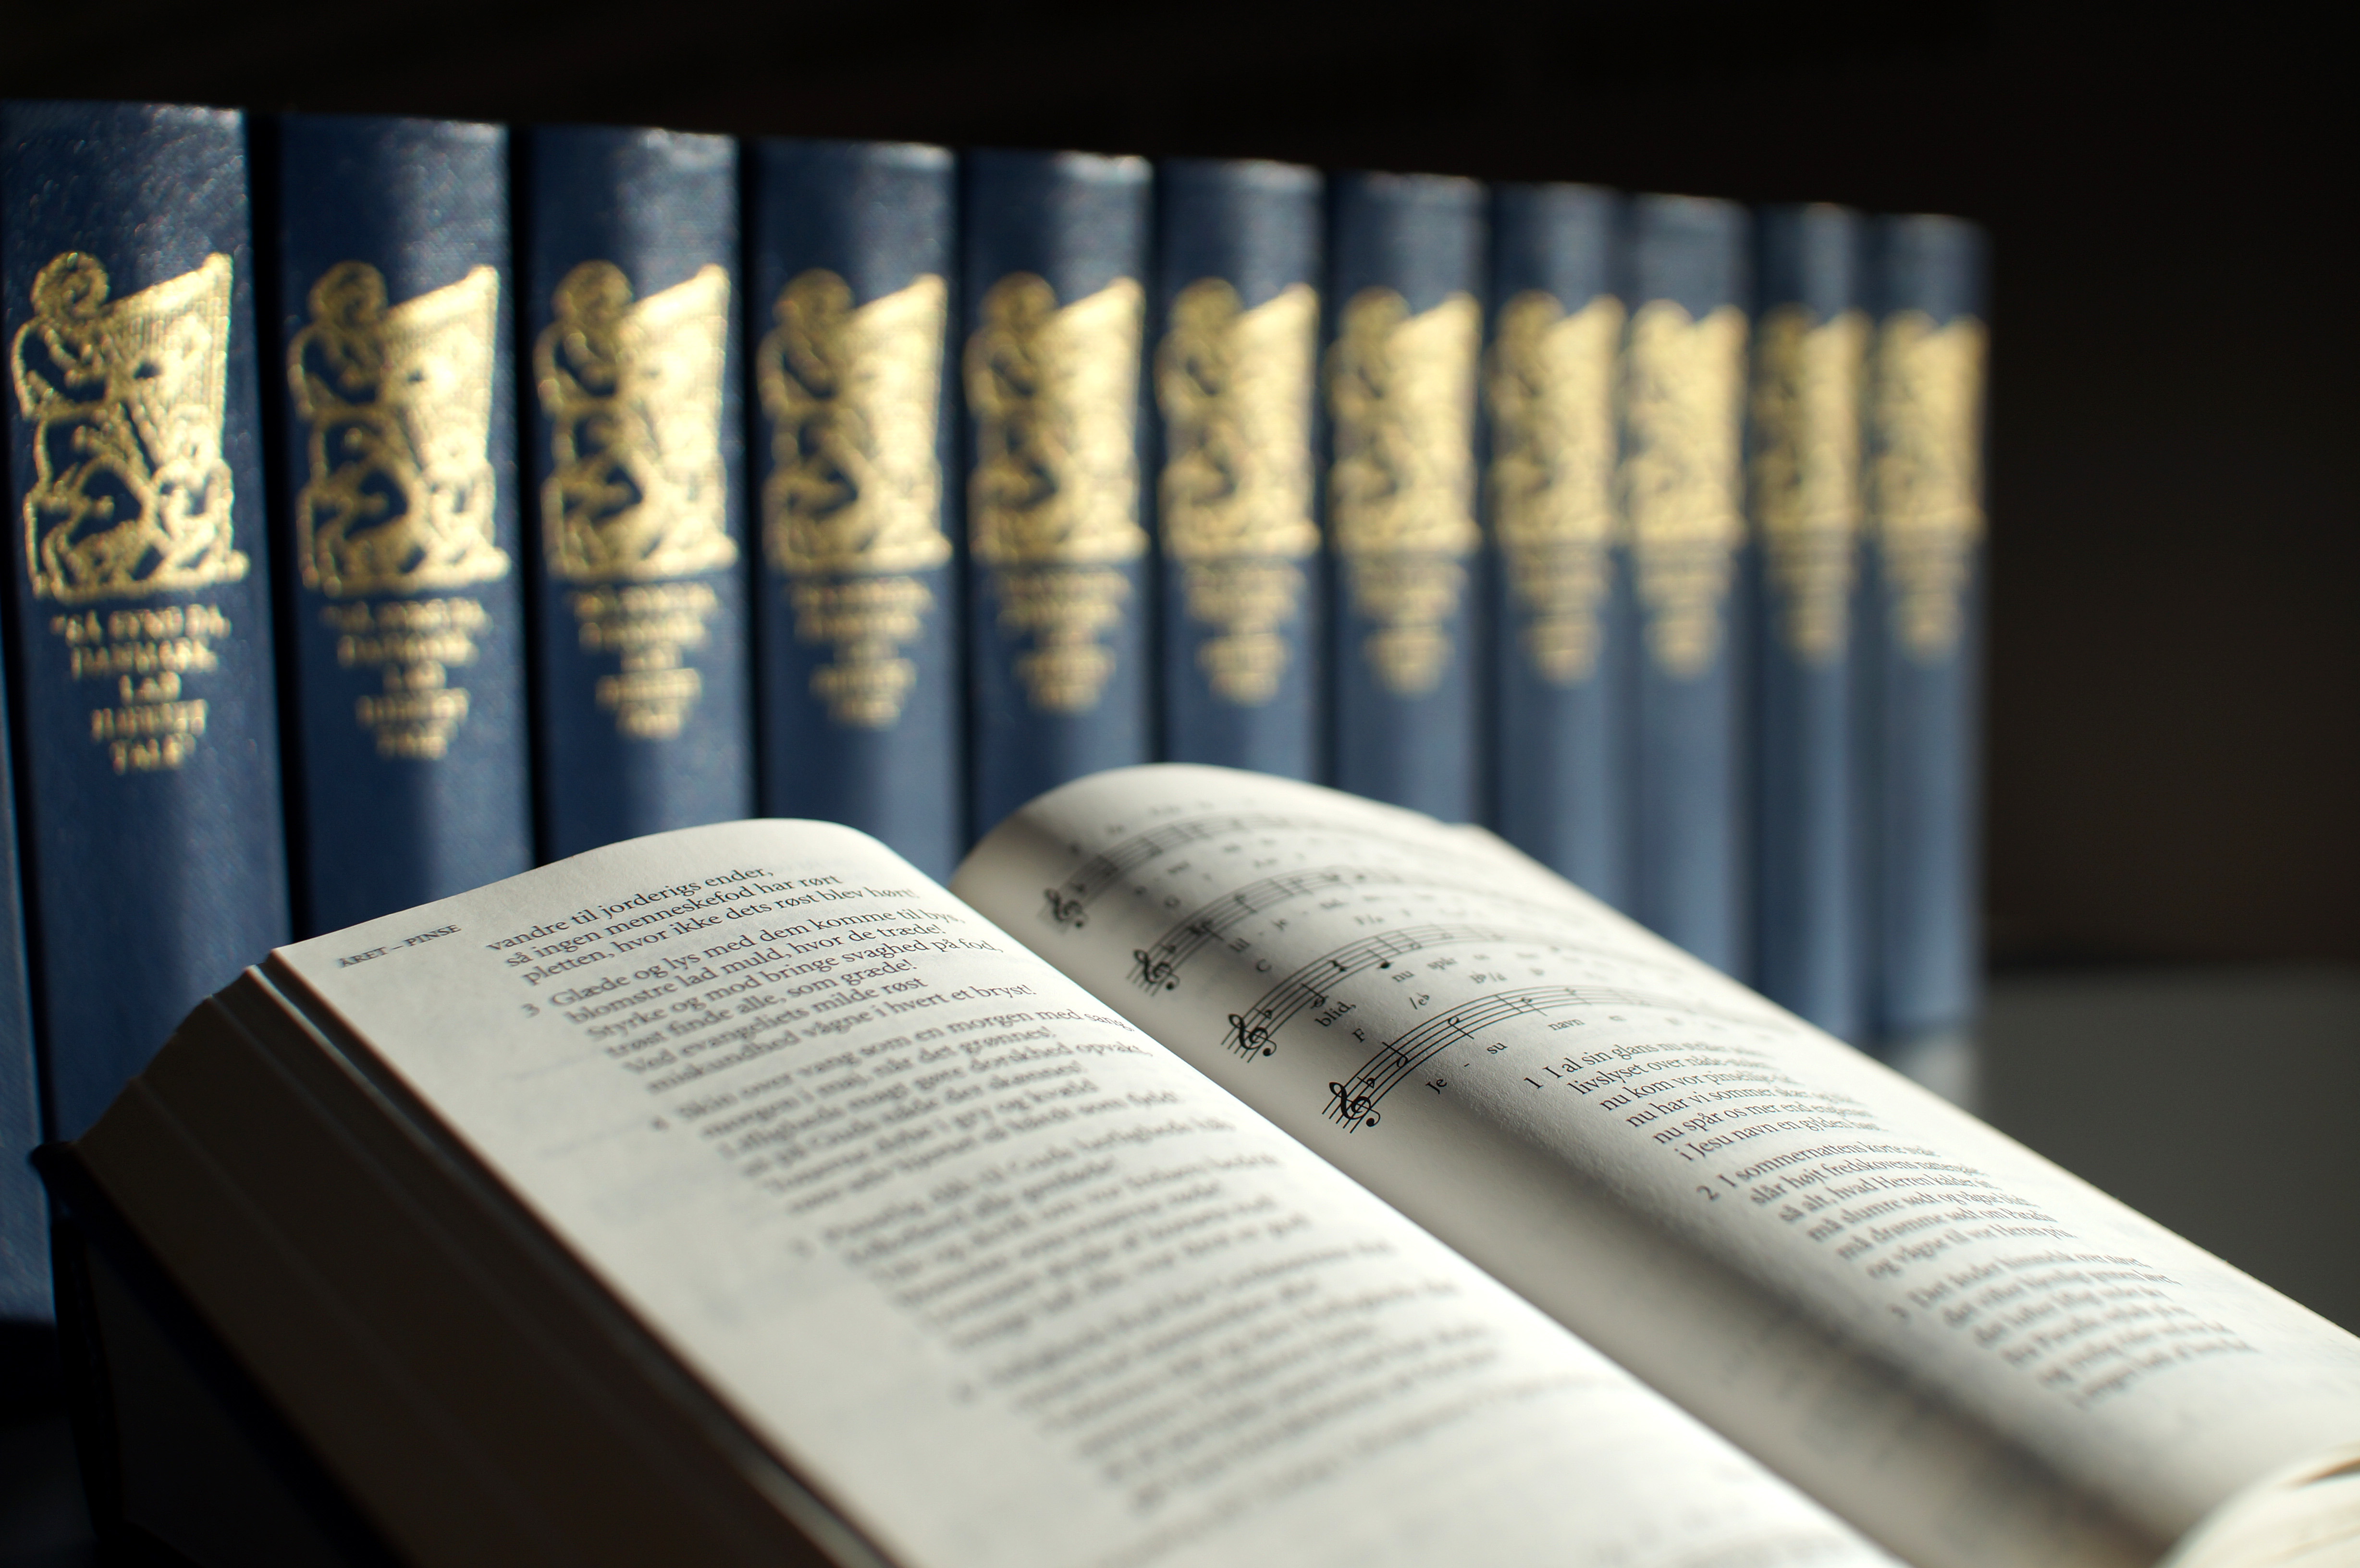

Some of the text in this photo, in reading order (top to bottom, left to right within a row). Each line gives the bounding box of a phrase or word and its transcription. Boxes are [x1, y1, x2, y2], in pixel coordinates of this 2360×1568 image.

[486, 868, 774, 951] vandre til jorderigs ender,
[506, 875, 843, 967] så ingen menneskefod har rørt
[339, 946, 389, 968] ÅRET
[403, 924, 462, 947] PINSE
[521, 951, 615, 985] pletten,
[611, 930, 670, 954] hvor
[670, 916, 723, 936] ikke
[726, 903, 773, 919] dets
[774, 892, 820, 909] røst
[817, 888, 865, 901] blev
[521, 1003, 540, 1018] 3
[548, 976, 631, 1007] Glæde
[633, 965, 669, 980] og
[662, 954, 701, 970] lys
[703, 935, 757, 958] med
[760, 923, 812, 942] dem
[807, 911, 896, 930] komme
[896, 908, 923, 919] til
[563, 923, 946, 1024] blomstre lad muld, hvor de træde!
[585, 938, 1004, 1041] Styrke og mod bringe svaghed på fod,
[735, 995, 787, 1014] alle,
[787, 978, 840, 998] som
[841, 959, 918, 986] græde!
[810, 988, 880, 1013] milde
[881, 978, 929, 995] røst
[870, 1004, 888, 1018] i
[883, 993, 950, 1015] hvert
[951, 988, 975, 1001] et
[968, 984, 1038, 999] bryst!
[1315, 1001, 1357, 1027] blid,
[1392, 970, 1415, 983] nu
[914, 1027, 946, 1042] en
[946, 1011, 1035, 1035] morgen
[1035, 1008, 1084, 1020] med
[1083, 1013, 1136, 1032] sang,
[1353, 1029, 1366, 1043] F
[1426, 1077, 1448, 1094] Je
[1487, 1041, 1508, 1054] su
[1547, 1017, 1586, 1031] navn
[1524, 1077, 1544, 1090] 1
[1542, 1066, 1563, 1079] I
[1562, 1057, 1584, 1073] al
[1582, 1052, 1613, 1065] sin
[1611, 1044, 1659, 1060] glans
[1657, 1043, 1684, 1051] nu
[1567, 1058, 1686, 1095] livslyset over
[1599, 1074, 1705, 1111] nu kom vor
[1626, 1110, 1659, 1127] nu
[1648, 1099, 1692, 1115] har
[1688, 1091, 1712, 1104] vi
[1708, 1088, 1779, 1099] sommer
[1653, 1101, 1815, 1144] nu spår os mer end
[1673, 1148, 1695, 1161] i
[1684, 1135, 1735, 1158] Jesu
[1731, 1123, 1780, 1140] navn
[1777, 1120, 1804, 1131] en
[1798, 1116, 1855, 1132] gylden
[1696, 1141, 1907, 1201] 2 I sommernattens korte
[1779, 1168, 1830, 1189] højt
[1820, 1158, 1919, 1177] fredskovens
[1824, 1177, 1879, 1200] hvad
[1868, 1176, 1936, 1189] Herren
